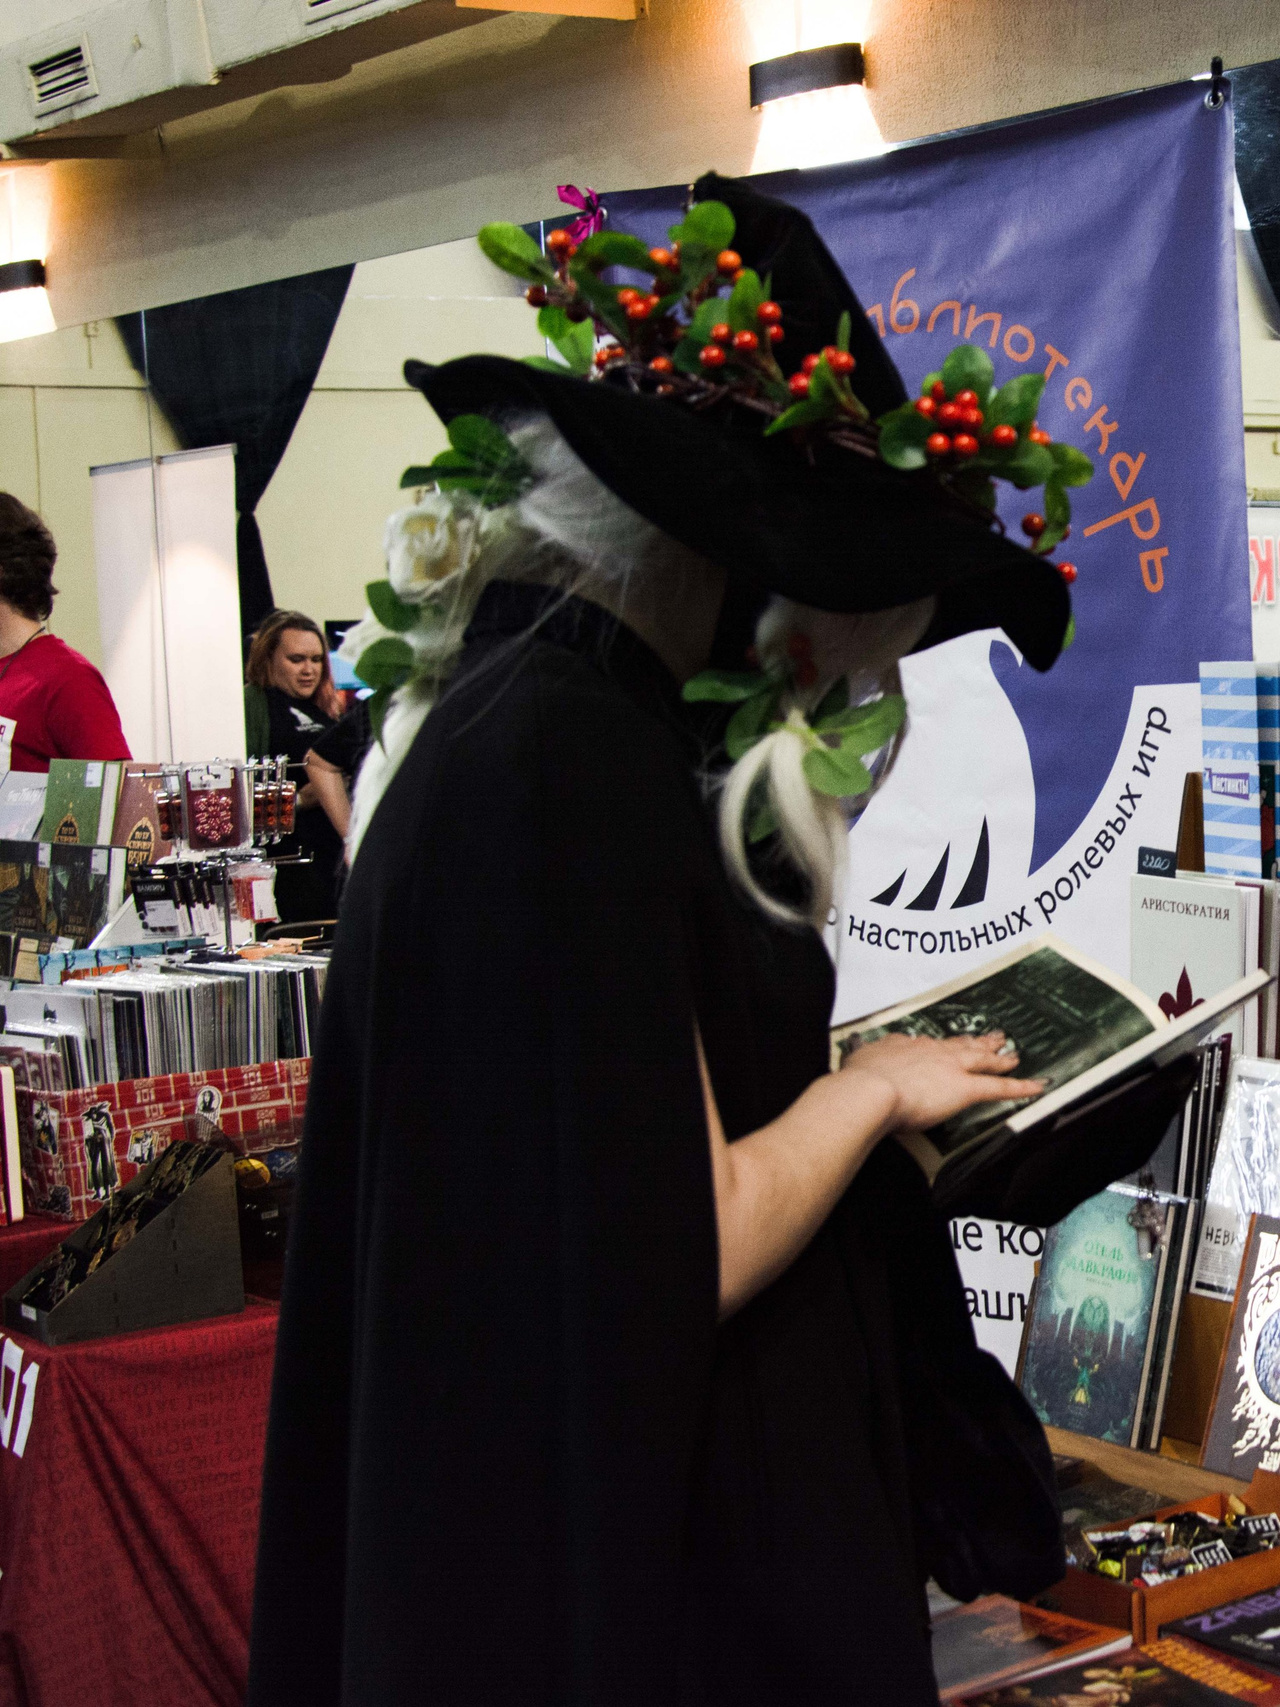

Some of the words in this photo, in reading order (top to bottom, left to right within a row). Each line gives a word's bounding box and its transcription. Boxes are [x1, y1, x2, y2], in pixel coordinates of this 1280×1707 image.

[849, 905, 1033, 955] настольных
[1034, 783, 1142, 924] ролевых
[1132, 706, 1172, 778] игр
[1141, 897, 1230, 920] АРИСТОКРАТИЯ
